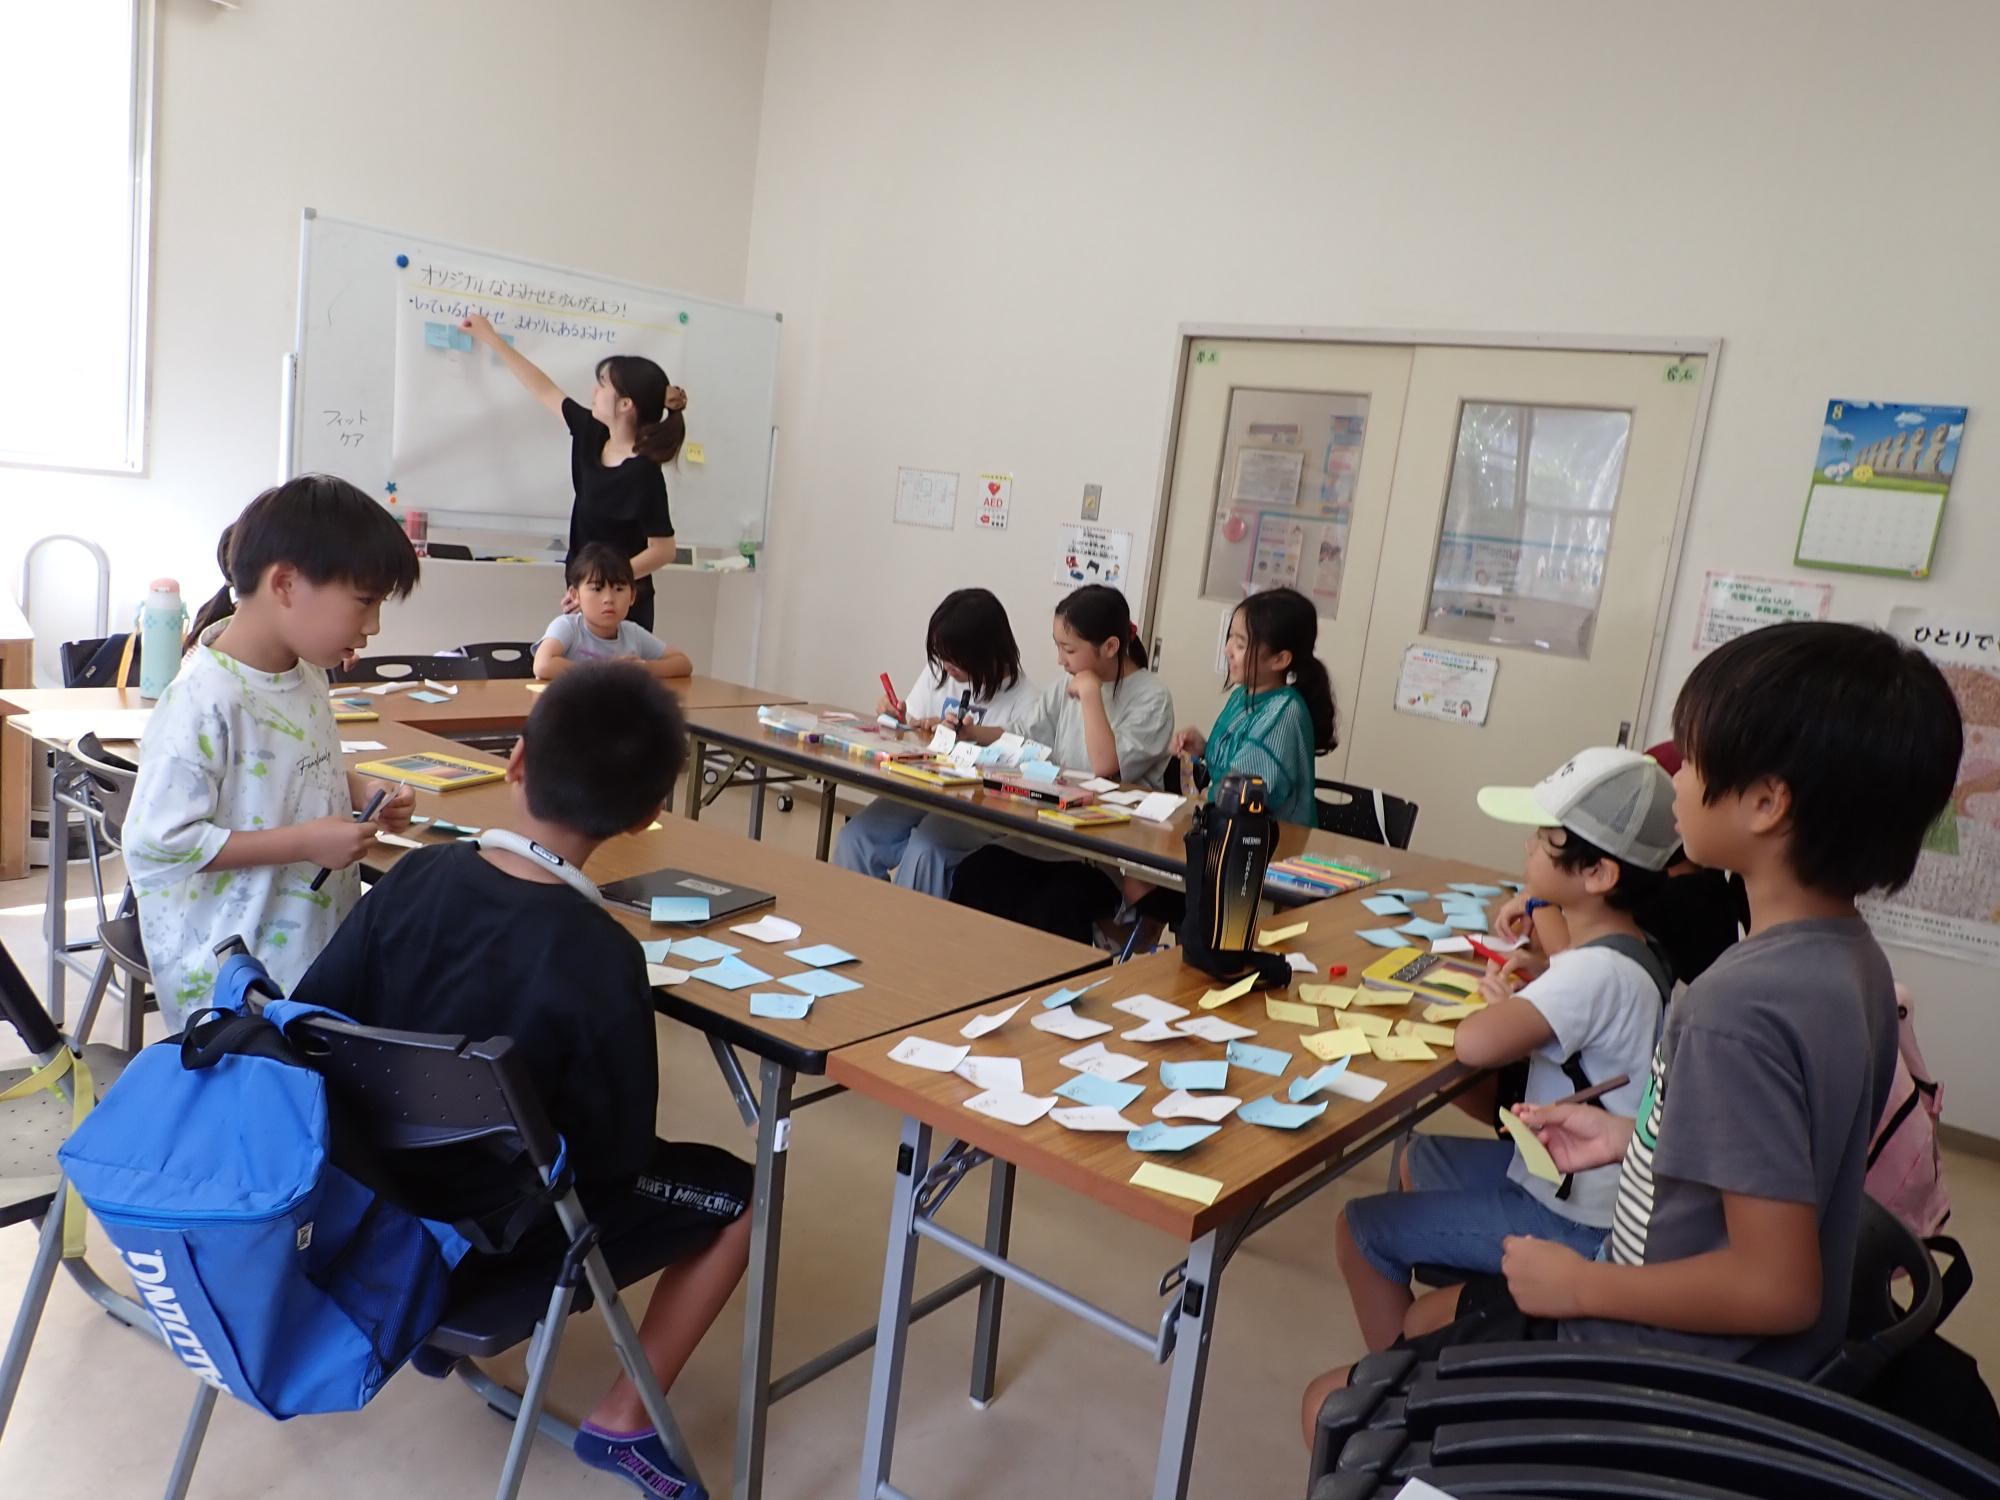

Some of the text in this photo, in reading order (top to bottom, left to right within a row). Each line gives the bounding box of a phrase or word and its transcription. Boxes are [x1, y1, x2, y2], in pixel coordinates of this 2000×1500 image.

[1832, 403, 1844, 421] 8
[340, 432, 364, 448] ケア
[984, 497, 1004, 508] AED
[1914, 626, 1994, 651] ひとりで
[636, 1174, 673, 1199] RAFT
[126, 1249, 234, 1394] ALDING
